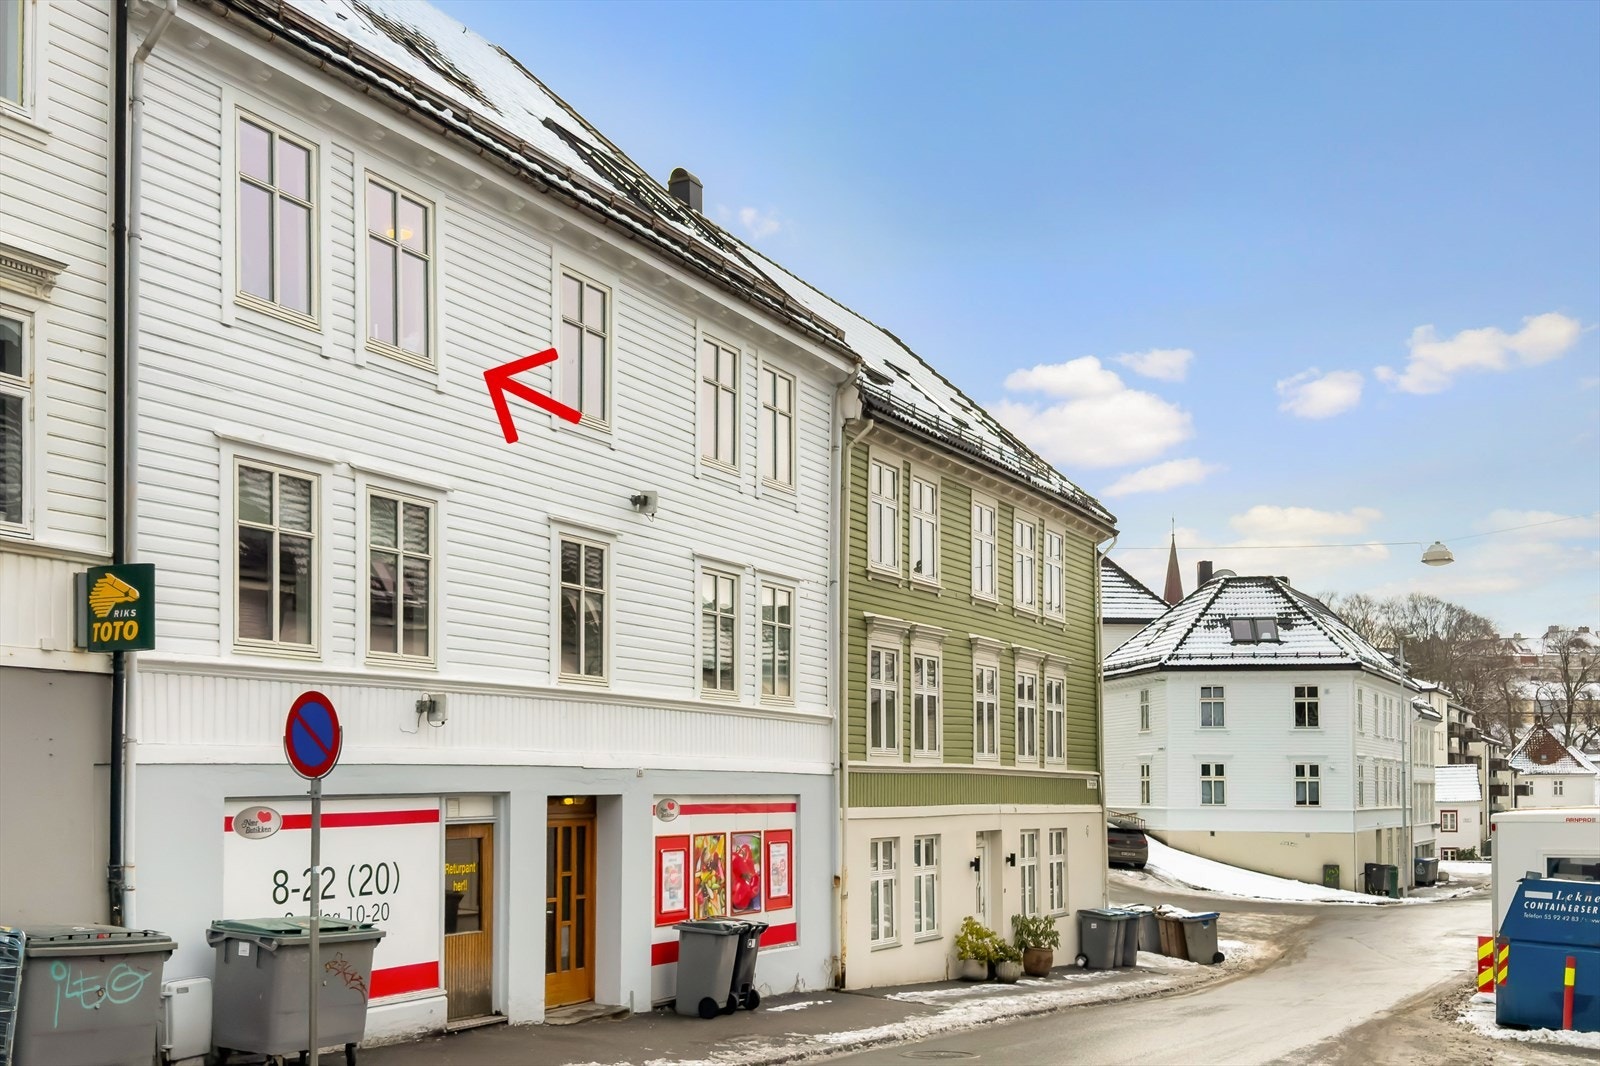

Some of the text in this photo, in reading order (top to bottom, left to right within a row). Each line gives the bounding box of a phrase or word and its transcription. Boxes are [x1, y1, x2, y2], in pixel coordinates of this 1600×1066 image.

[113, 609, 137, 618] RIKS
[92, 620, 139, 643] TOTO
[445, 862, 476, 876] Returpant
[272, 861, 400, 905] 8-22 (20)
[346, 902, 390, 923] 10-20
[1523, 912, 1543, 920] Telefon
